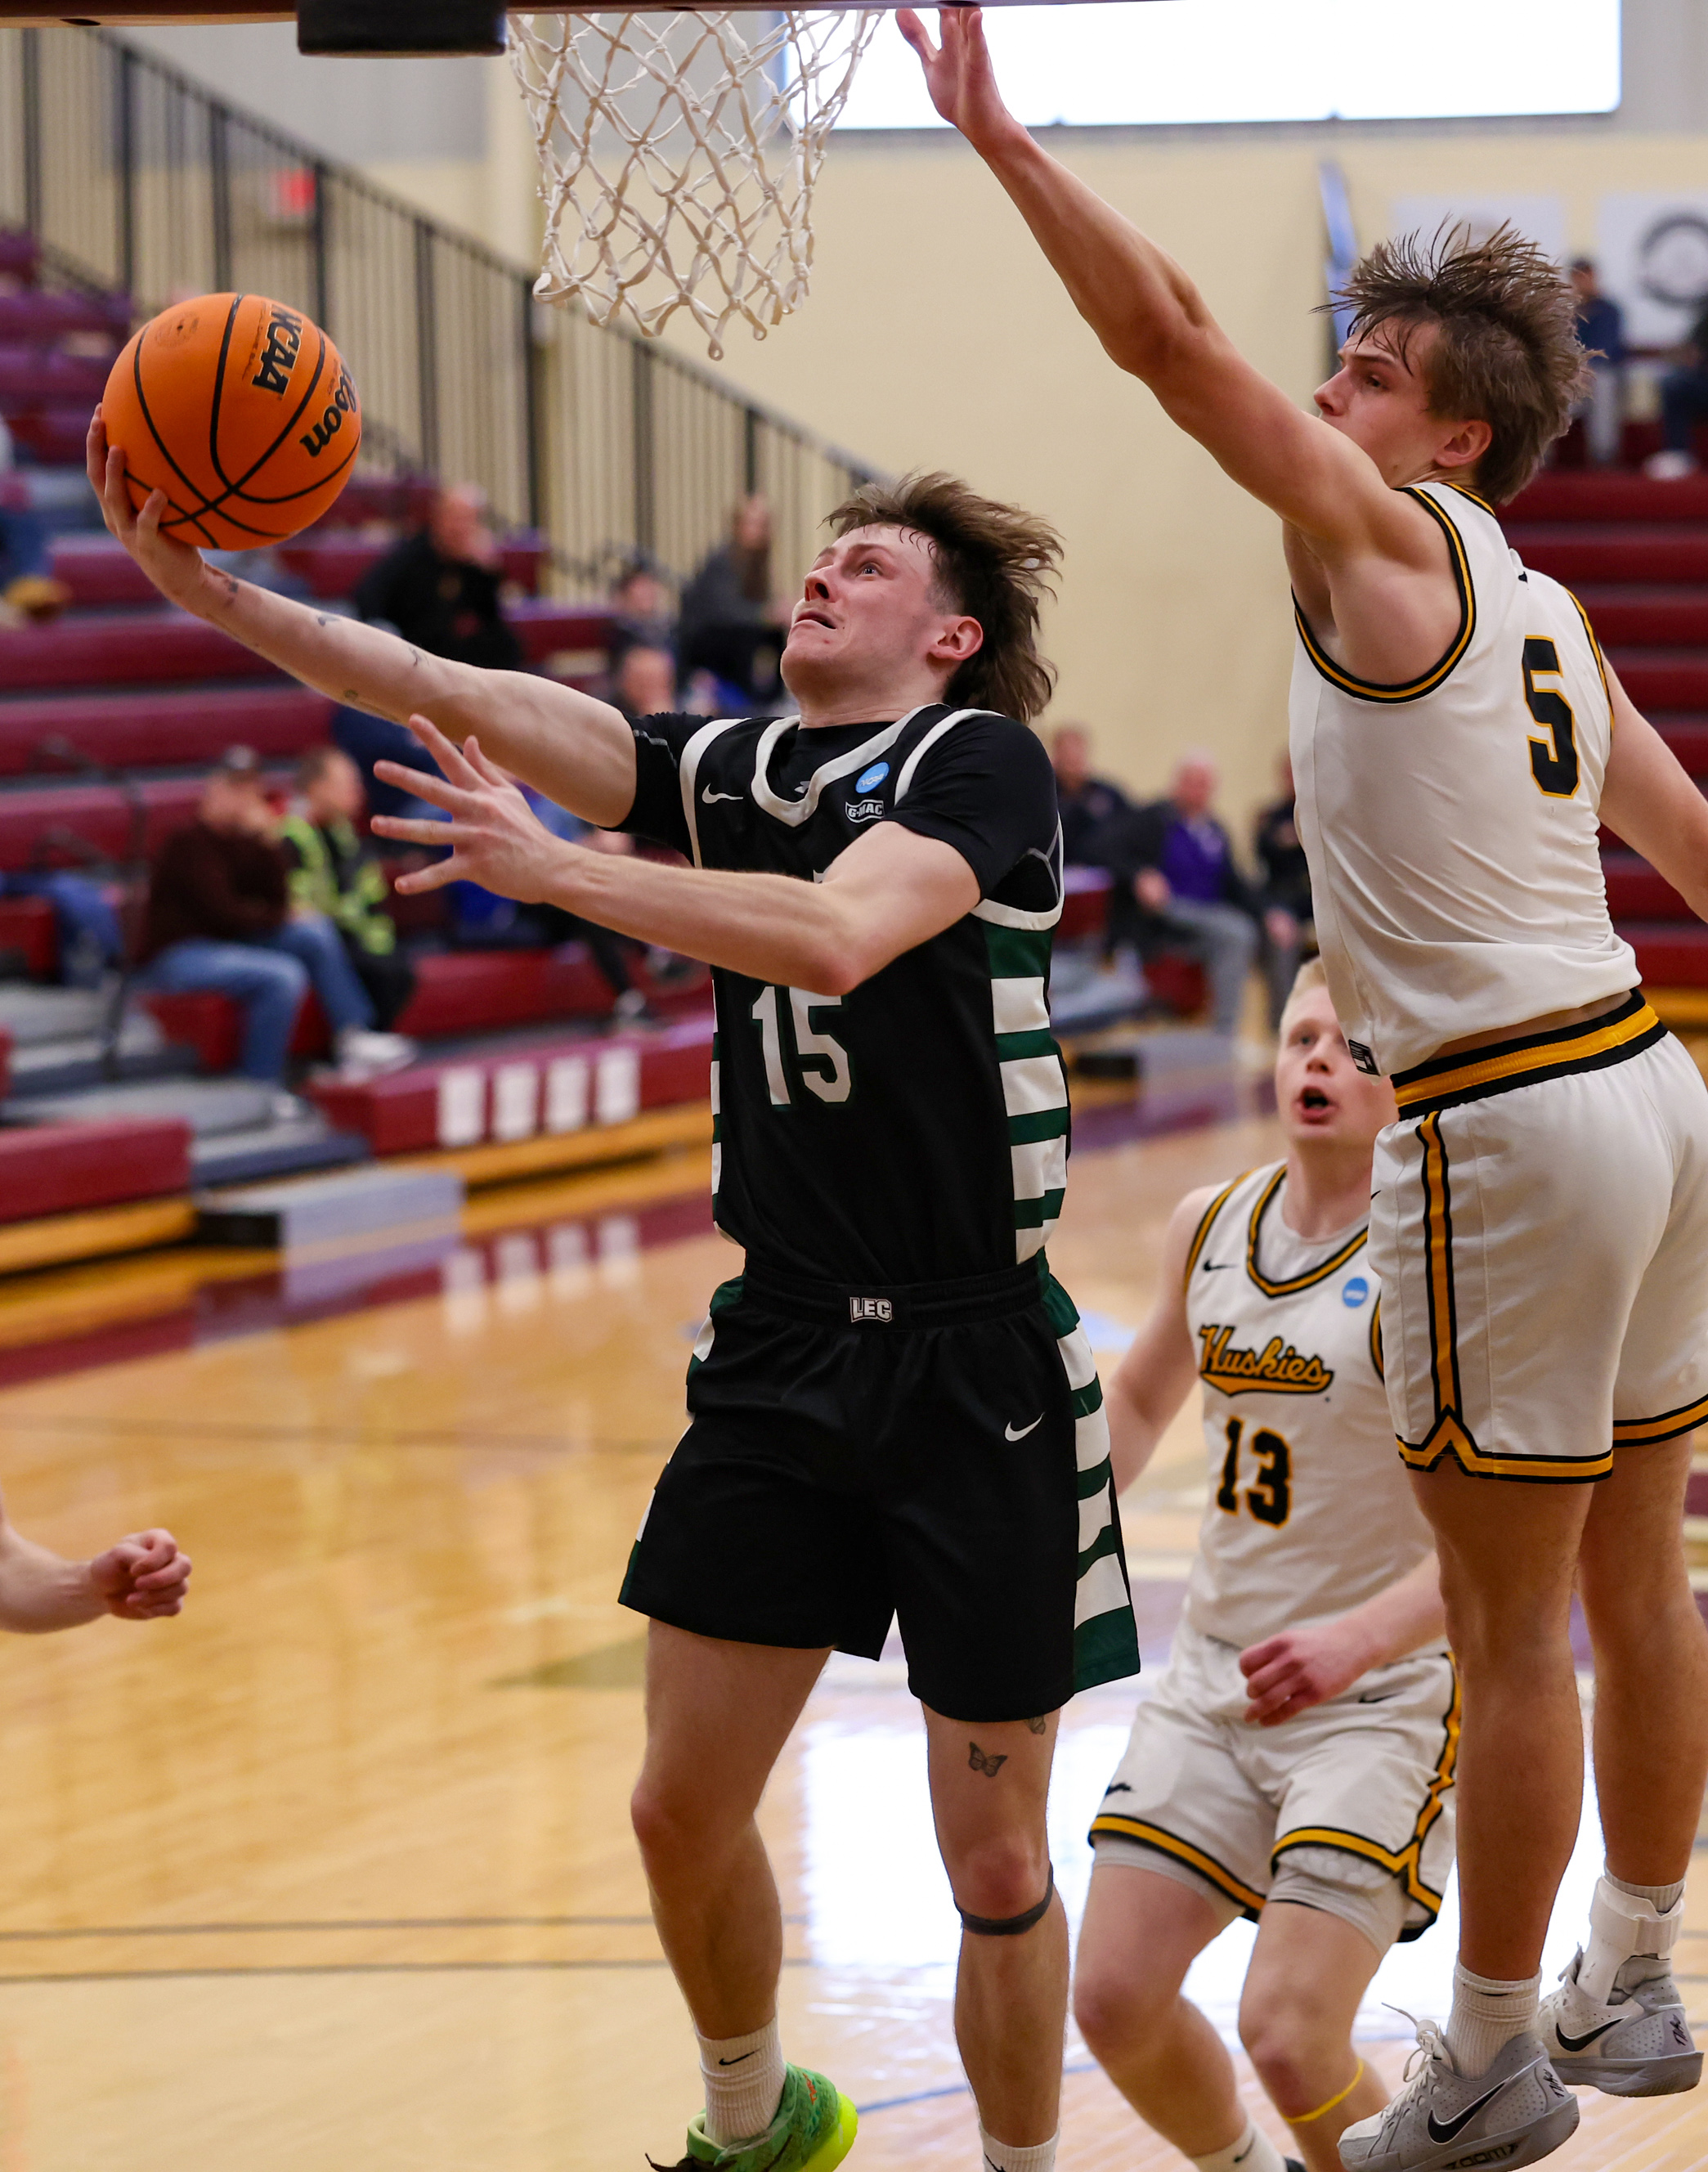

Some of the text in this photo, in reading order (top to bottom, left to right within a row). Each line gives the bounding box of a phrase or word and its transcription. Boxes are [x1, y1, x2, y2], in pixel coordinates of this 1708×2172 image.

[251, 303, 303, 396] NCAA
[1522, 635, 1581, 800] 5
[751, 985, 854, 1107] 15
[1199, 1324, 1335, 1393] Huskies
[1216, 1416, 1293, 1530] 13
